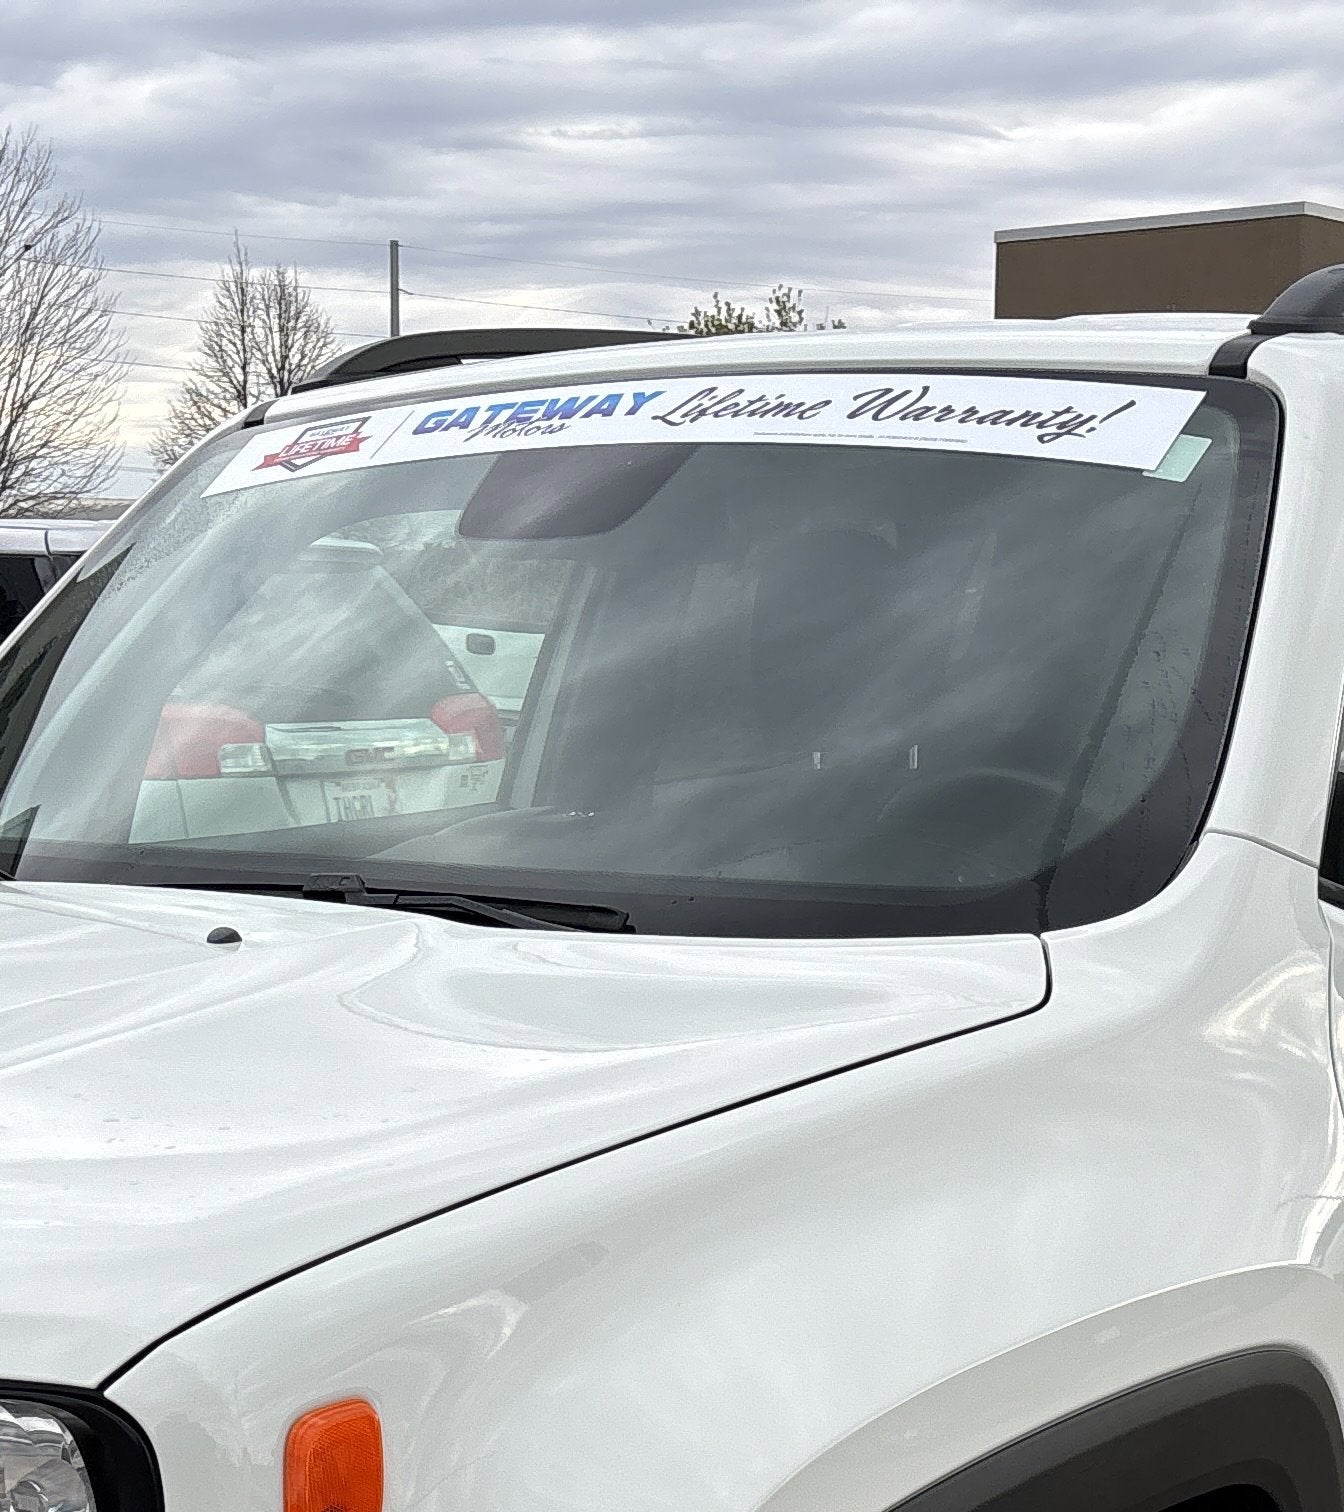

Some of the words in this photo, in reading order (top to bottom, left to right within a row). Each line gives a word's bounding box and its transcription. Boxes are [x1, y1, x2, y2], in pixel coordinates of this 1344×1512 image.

[411, 390, 668, 436] GATEWAY
[462, 416, 572, 443] Motors
[650, 386, 833, 427] Lifetime
[845, 384, 1137, 445] Warranty!
[278, 434, 354, 458] LIFETIME
